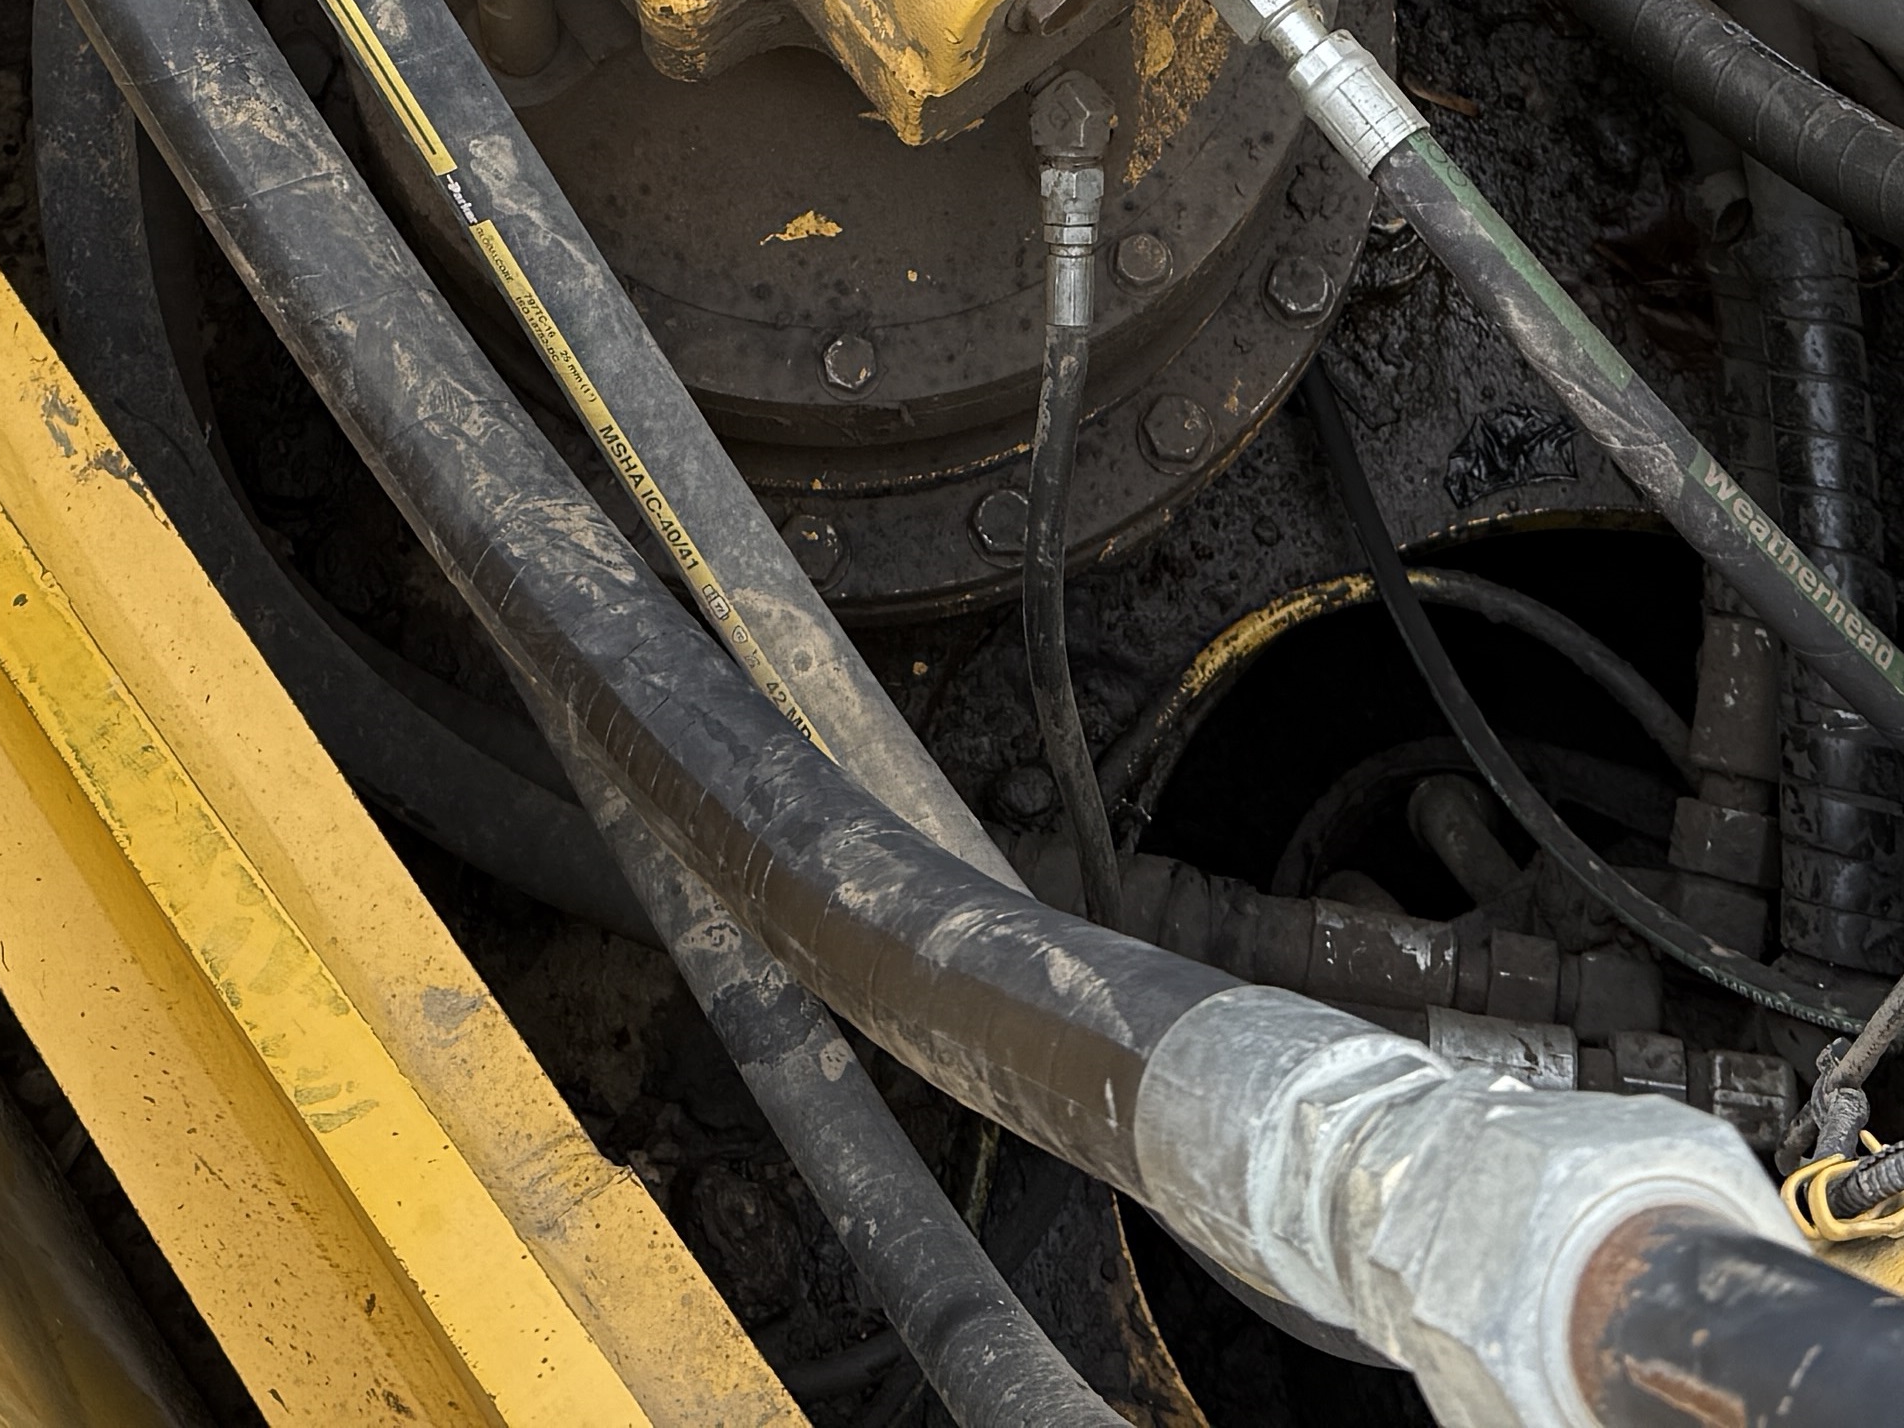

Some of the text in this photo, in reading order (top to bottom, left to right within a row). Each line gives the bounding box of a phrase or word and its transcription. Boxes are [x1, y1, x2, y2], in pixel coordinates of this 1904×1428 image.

[445, 178, 482, 227] Parker
[523, 291, 557, 339] 797TC-16
[566, 362, 584, 384] mm
[597, 423, 647, 489] MSHA
[638, 487, 701, 572] IC-40/41
[763, 677, 789, 707] 42
[782, 706, 813, 744] MP
[1693, 461, 1904, 673] Weatherhead
